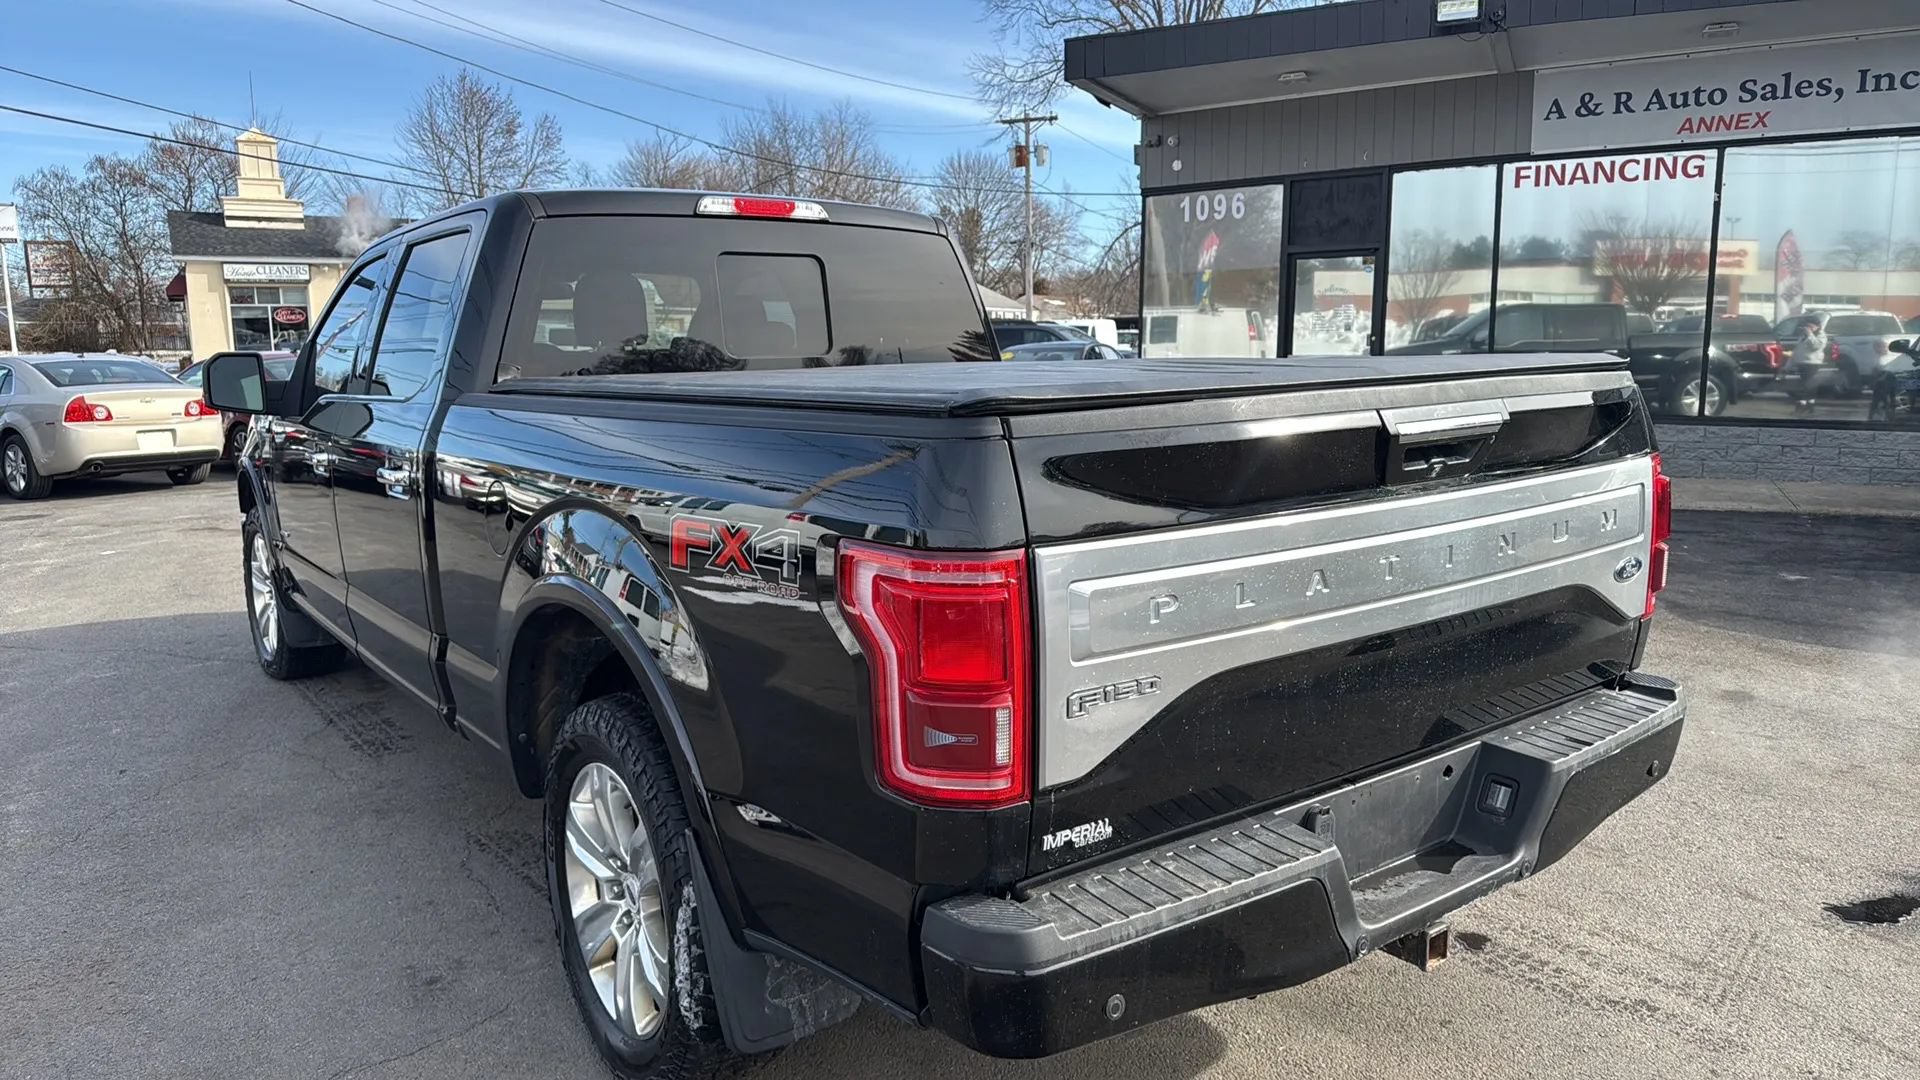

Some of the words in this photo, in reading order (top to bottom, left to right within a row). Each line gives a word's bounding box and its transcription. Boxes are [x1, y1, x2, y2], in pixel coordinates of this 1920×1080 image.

[1543, 98, 1567, 121] A
[1575, 92, 1605, 118] &
[1612, 91, 1636, 115] R
[1643, 86, 1728, 112] Auto
[1738, 71, 1844, 103] Sales,
[1676, 110, 1772, 136] ANNEX
[1514, 154, 1706, 189] FINANCING
[1180, 192, 1246, 223] 1096
[255, 265, 308, 276] CLEANERS
[669, 513, 801, 588] FX4
[1149, 508, 1618, 625] PLATINUM
[1043, 817, 1113, 851] IMPERIAL
